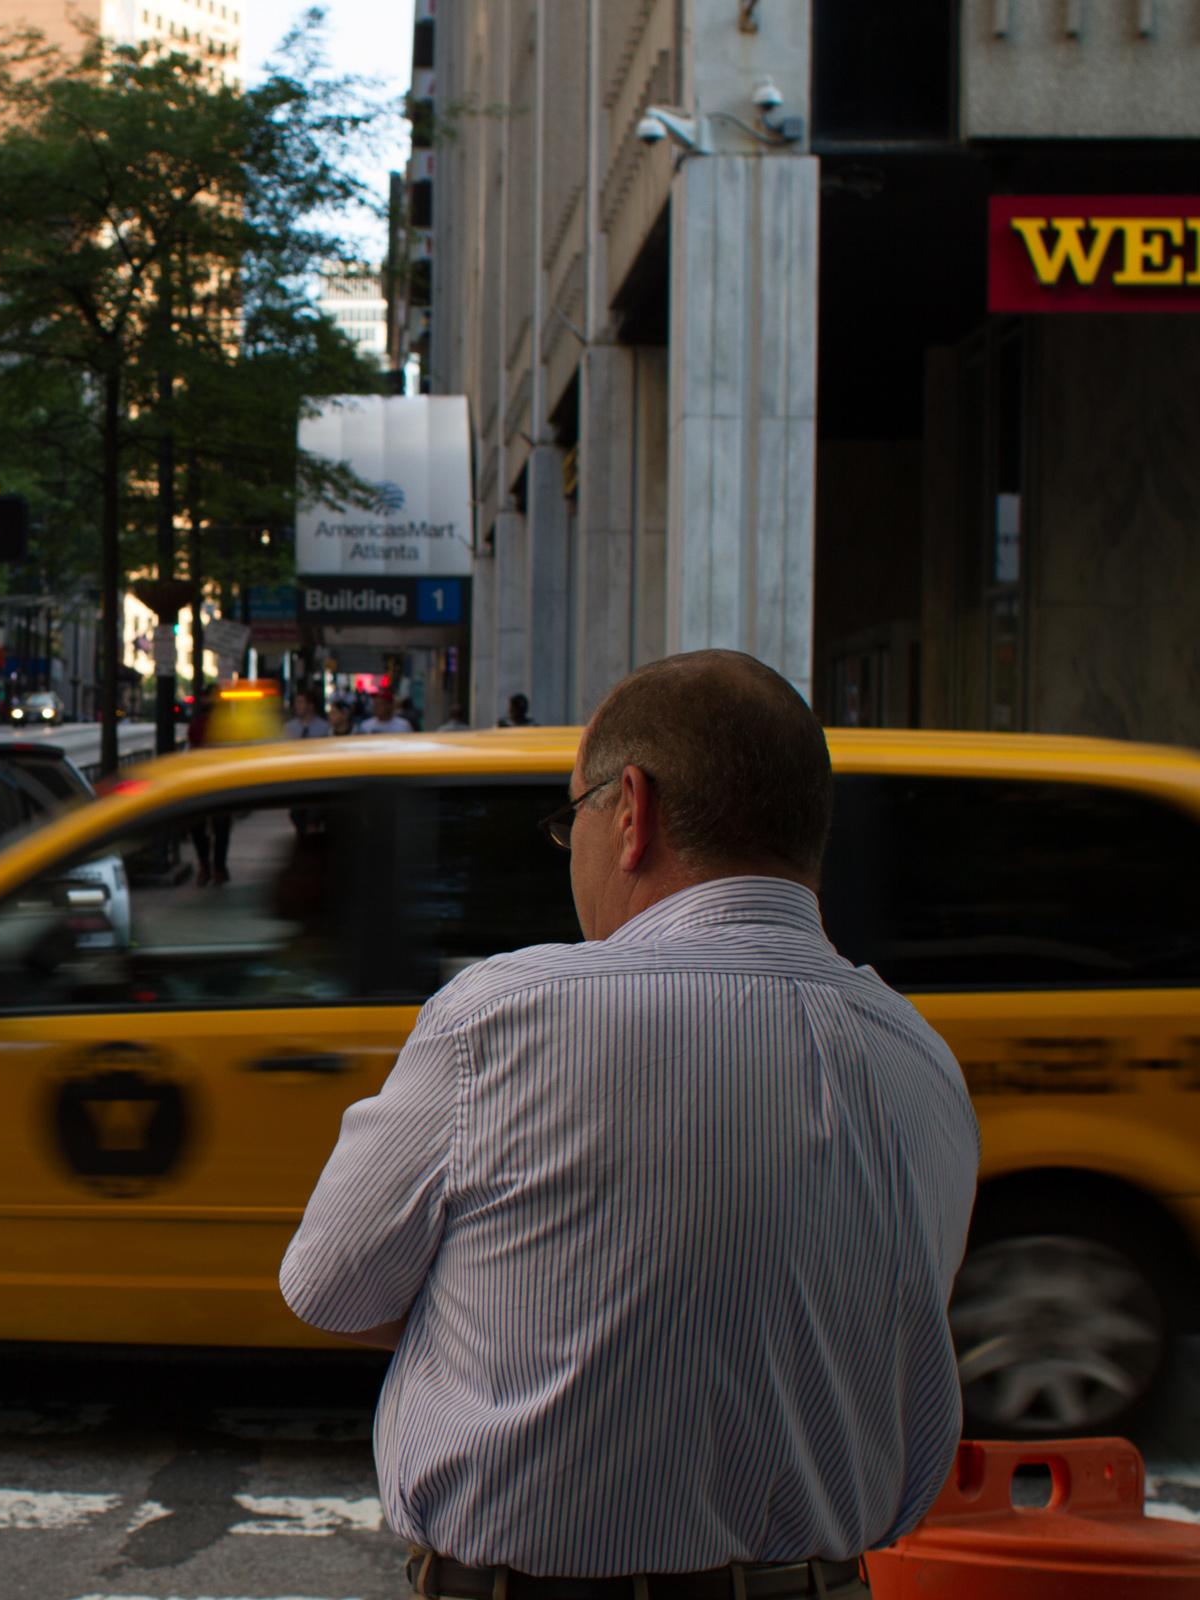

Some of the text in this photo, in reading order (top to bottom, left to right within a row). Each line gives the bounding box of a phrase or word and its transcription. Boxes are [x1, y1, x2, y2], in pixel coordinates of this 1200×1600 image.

[1010, 217, 1200, 285] WE
[315, 521, 455, 538] AmericasMart
[349, 542, 420, 561] Atlanta
[305, 588, 445, 616] Building 1
